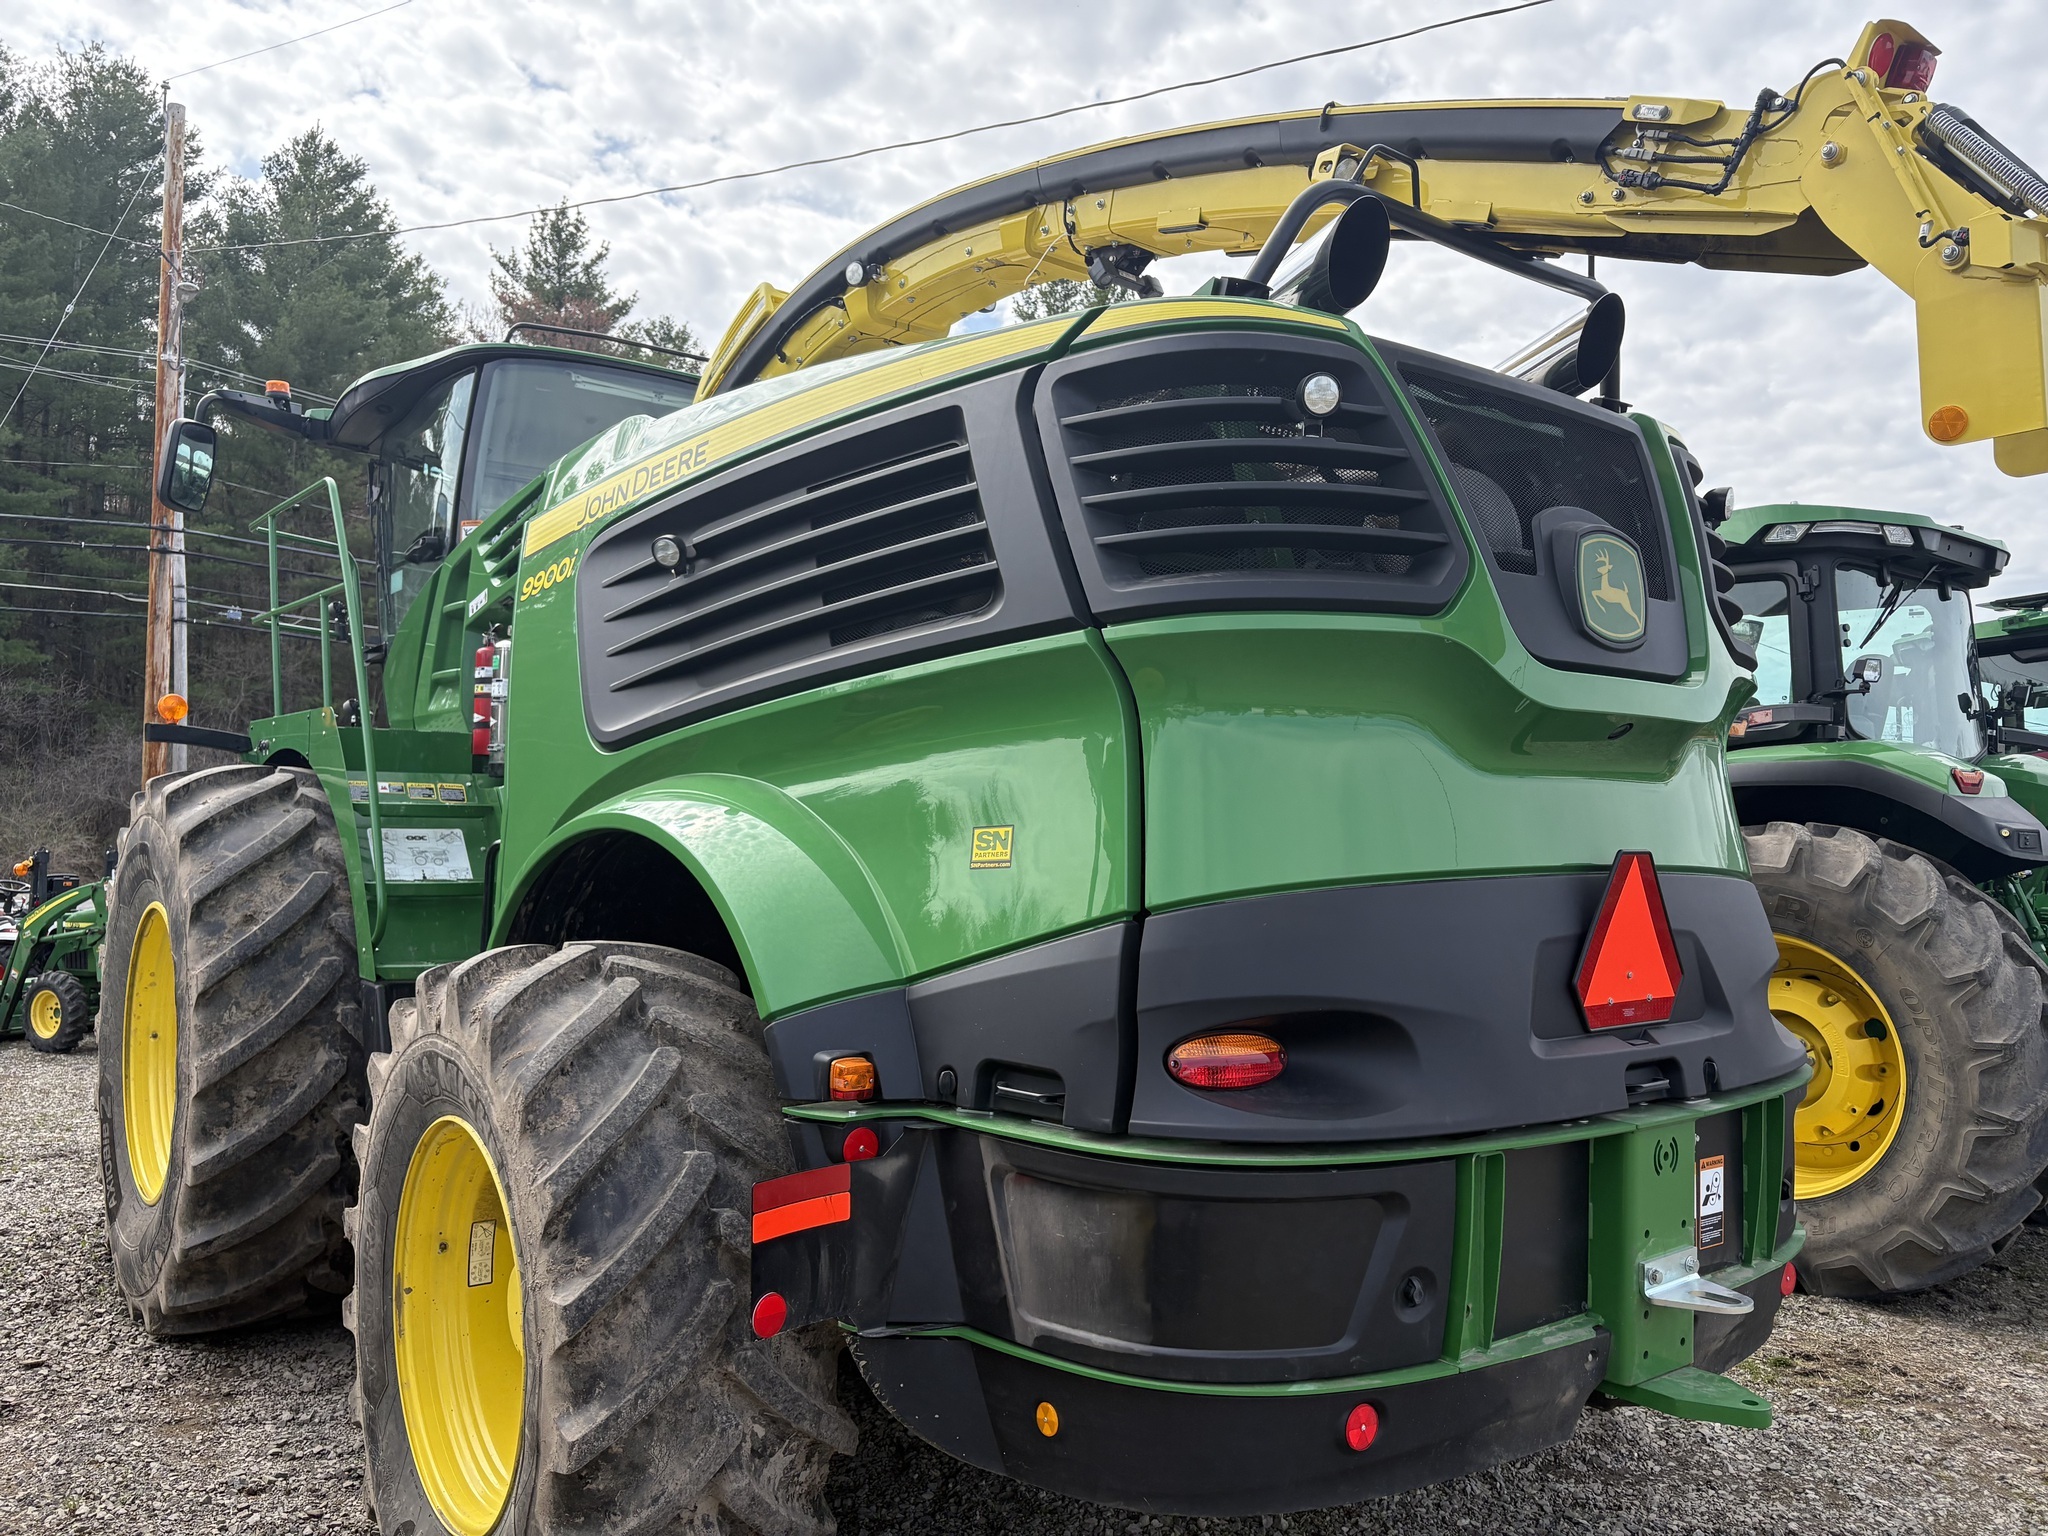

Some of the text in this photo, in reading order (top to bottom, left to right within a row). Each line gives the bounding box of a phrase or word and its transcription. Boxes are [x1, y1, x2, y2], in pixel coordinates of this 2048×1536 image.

[577, 439, 710, 527] JOHN DEERE
[519, 548, 579, 602] 9900i
[976, 830, 1010, 851] SN
[1886, 986, 1946, 1203] OPTITRAC
[101, 1121, 118, 1210] AXIOBIB
[1705, 1158, 1723, 1167] WARNING
